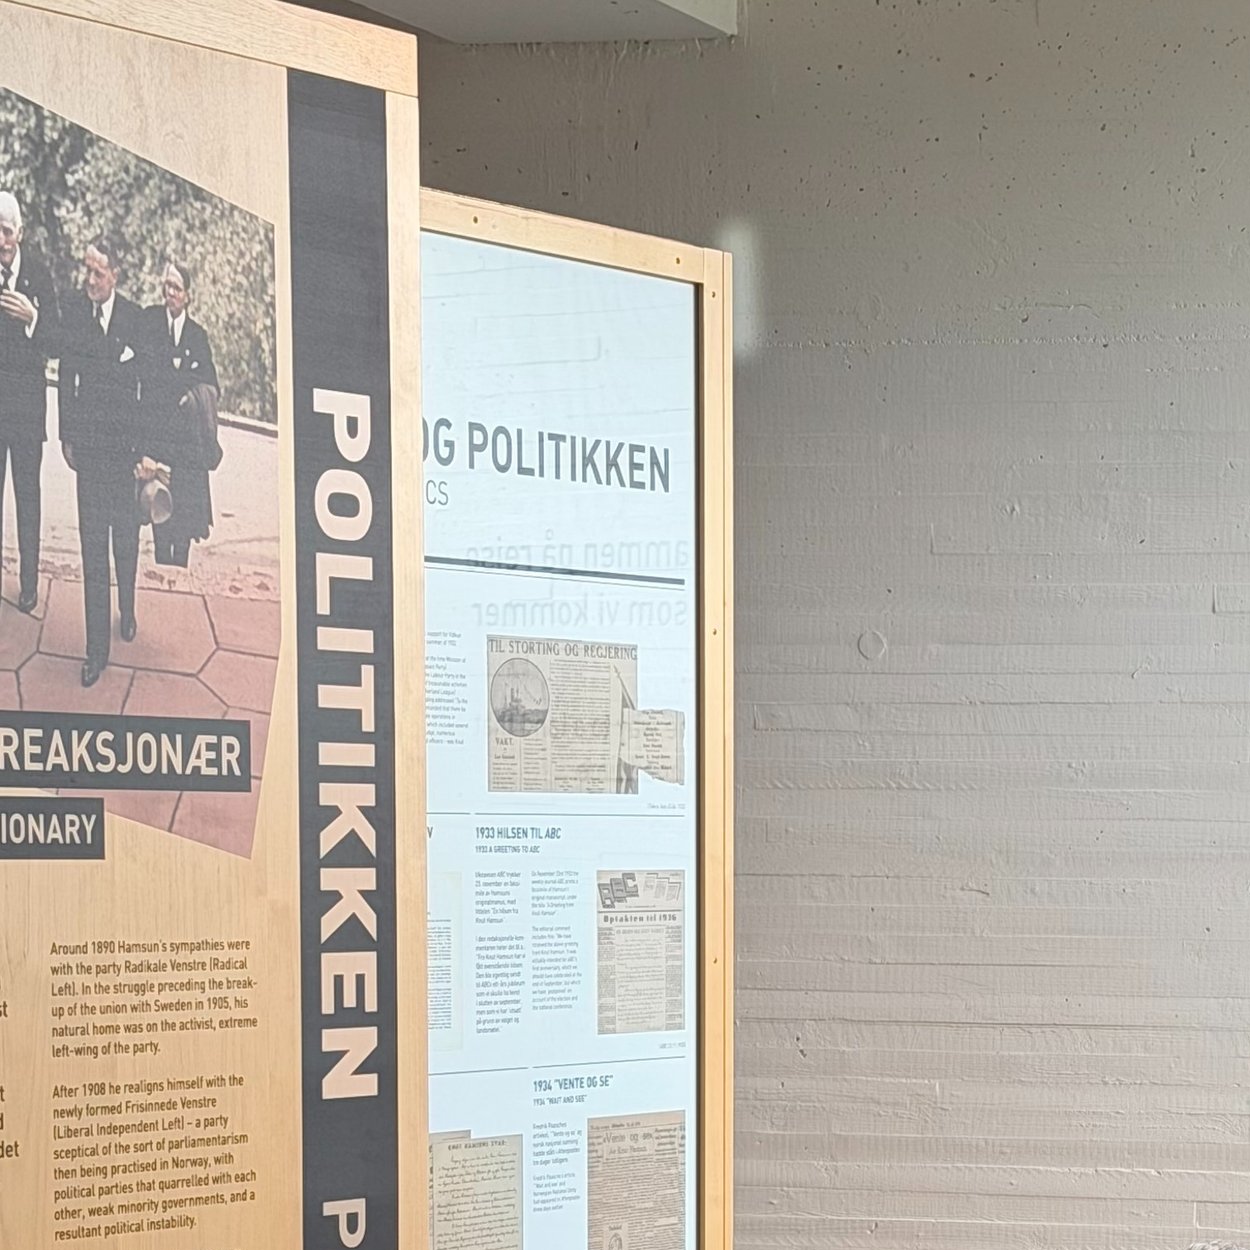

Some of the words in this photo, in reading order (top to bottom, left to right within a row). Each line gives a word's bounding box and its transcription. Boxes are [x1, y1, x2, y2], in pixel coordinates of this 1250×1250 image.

[468, 421, 670, 492] POLITIKKEN
[425, 480, 449, 505] CS
[489, 639, 505, 653] TIL
[509, 640, 560, 656] STORTING
[565, 642, 579, 657] OG
[584, 644, 638, 661] REGJERING
[313, 388, 378, 1100] POLITIKKEN
[1, 813, 97, 844] IONARY
[475, 827, 495, 839] 1933
[497, 827, 528, 839] HILSEN
[531, 828, 543, 839] TIL
[545, 828, 561, 839] ABC
[50, 942, 88, 955] Around
[92, 940, 116, 954] 1890
[118, 940, 167, 953] Hamsun's
[169, 939, 225, 955] sympathies
[227, 940, 250, 950] were
[51, 1006, 65, 1020] up
[67, 1002, 77, 1016] of
[80, 1002, 97, 1016] the
[99, 1001, 128, 1015] union
[130, 1000, 152, 1013] with
[154, 999, 193, 1012] Sweden
[195, 998, 204, 1010] in
[207, 996, 232, 1010] 1905,
[234, 996, 248, 1008] his
[52, 1023, 90, 1037] natural
[92, 1023, 121, 1035] home
[123, 1023, 144, 1033] was
[146, 1022, 158, 1032] on
[160, 1019, 177, 1032] the
[179, 1017, 216, 1031] activist,
[218, 1017, 258, 1029] extreme
[52, 1085, 79, 1098] After
[82, 1082, 106, 1096] 1908
[108, 1082, 121, 1094] he
[123, 1080, 164, 1095] realigns
[166, 1076, 204, 1090] himself
[205, 1075, 226, 1088] with
[228, 1074, 244, 1086] the
[533, 1080, 552, 1092] 1934
[587, 1076, 598, 1088] OG
[53, 1105, 83, 1120] newly
[85, 1102, 123, 1116] formed
[125, 1099, 178, 1113] Frisinnede
[180, 1097, 217, 1109] Venstre
[54, 1207, 85, 1220] other,
[88, 1203, 115, 1217] weak
[117, 1199, 159, 1214] minority
[161, 1193, 227, 1213] governments,
[230, 1189, 248, 1203] and
[249, 1191, 255, 1200] a
